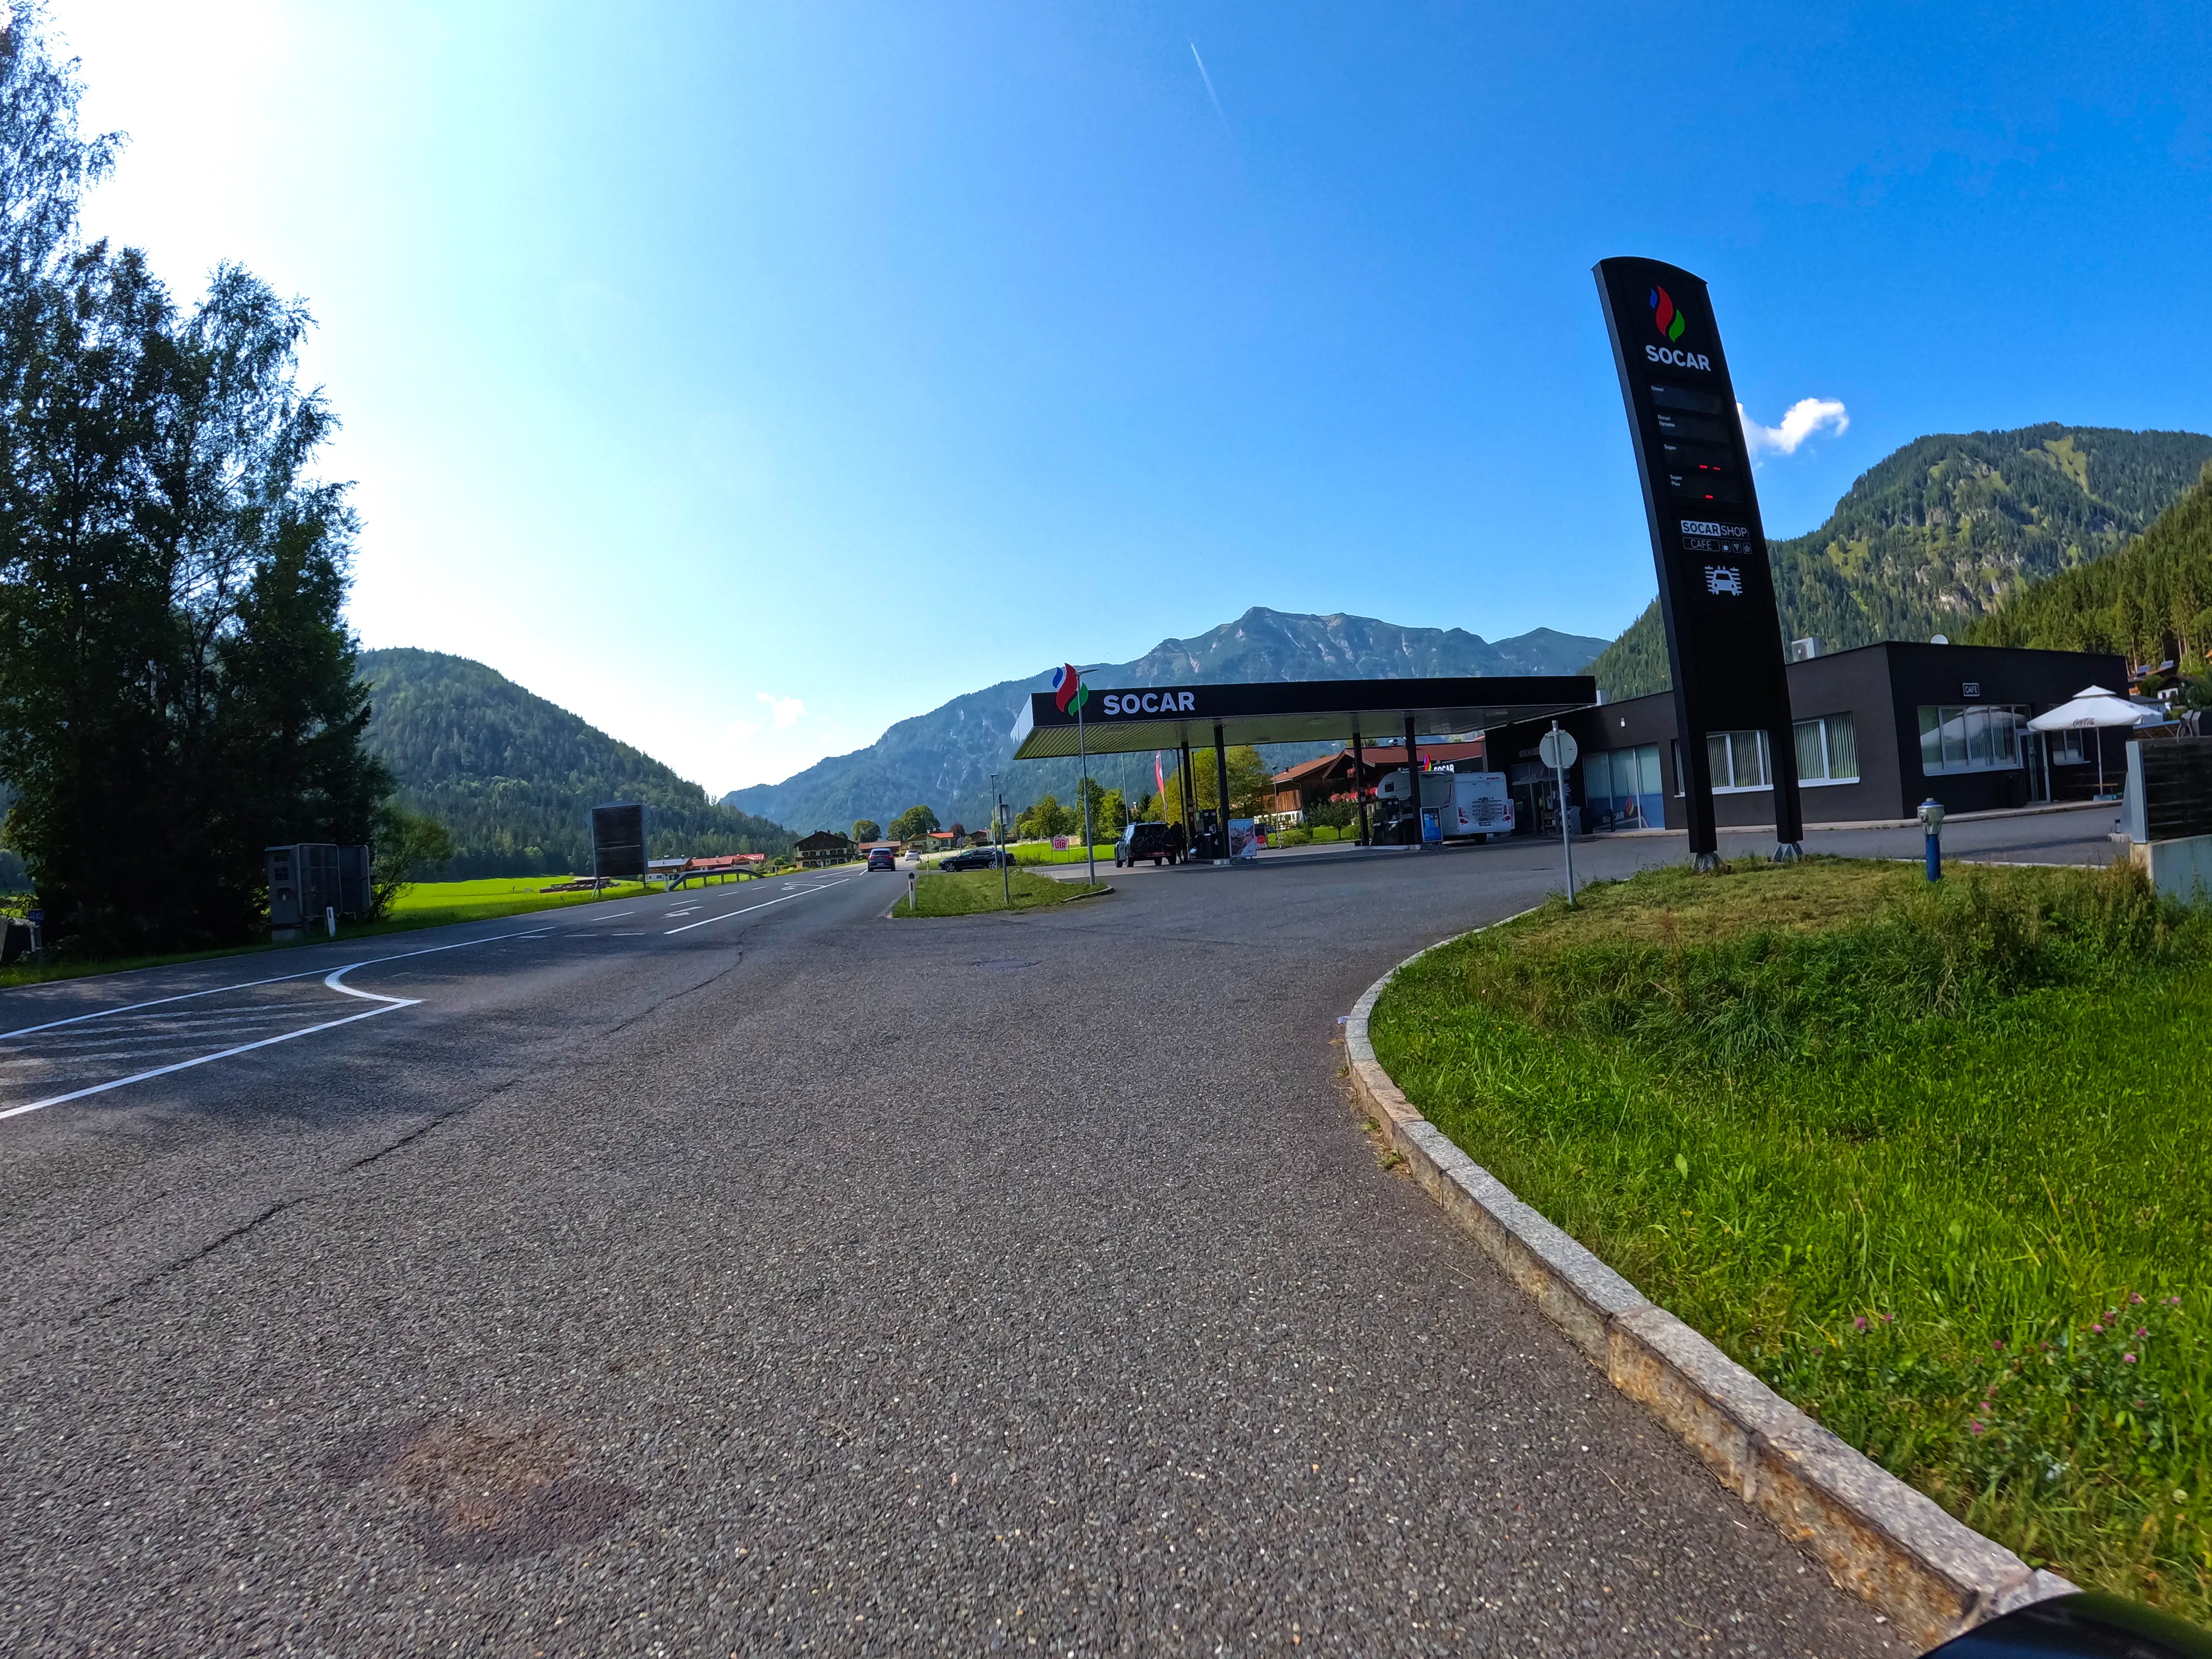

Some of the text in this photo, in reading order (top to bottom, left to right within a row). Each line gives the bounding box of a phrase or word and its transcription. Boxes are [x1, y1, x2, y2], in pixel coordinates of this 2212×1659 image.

[1645, 345, 1711, 372] SOCAR
[1651, 385, 1664, 393] Diesel
[1691, 539, 1712, 550] CAFE
[1103, 692, 1196, 715] SOCAR
[1434, 764, 1454, 773] SOCAR
[1054, 839, 1067, 849] UTA
